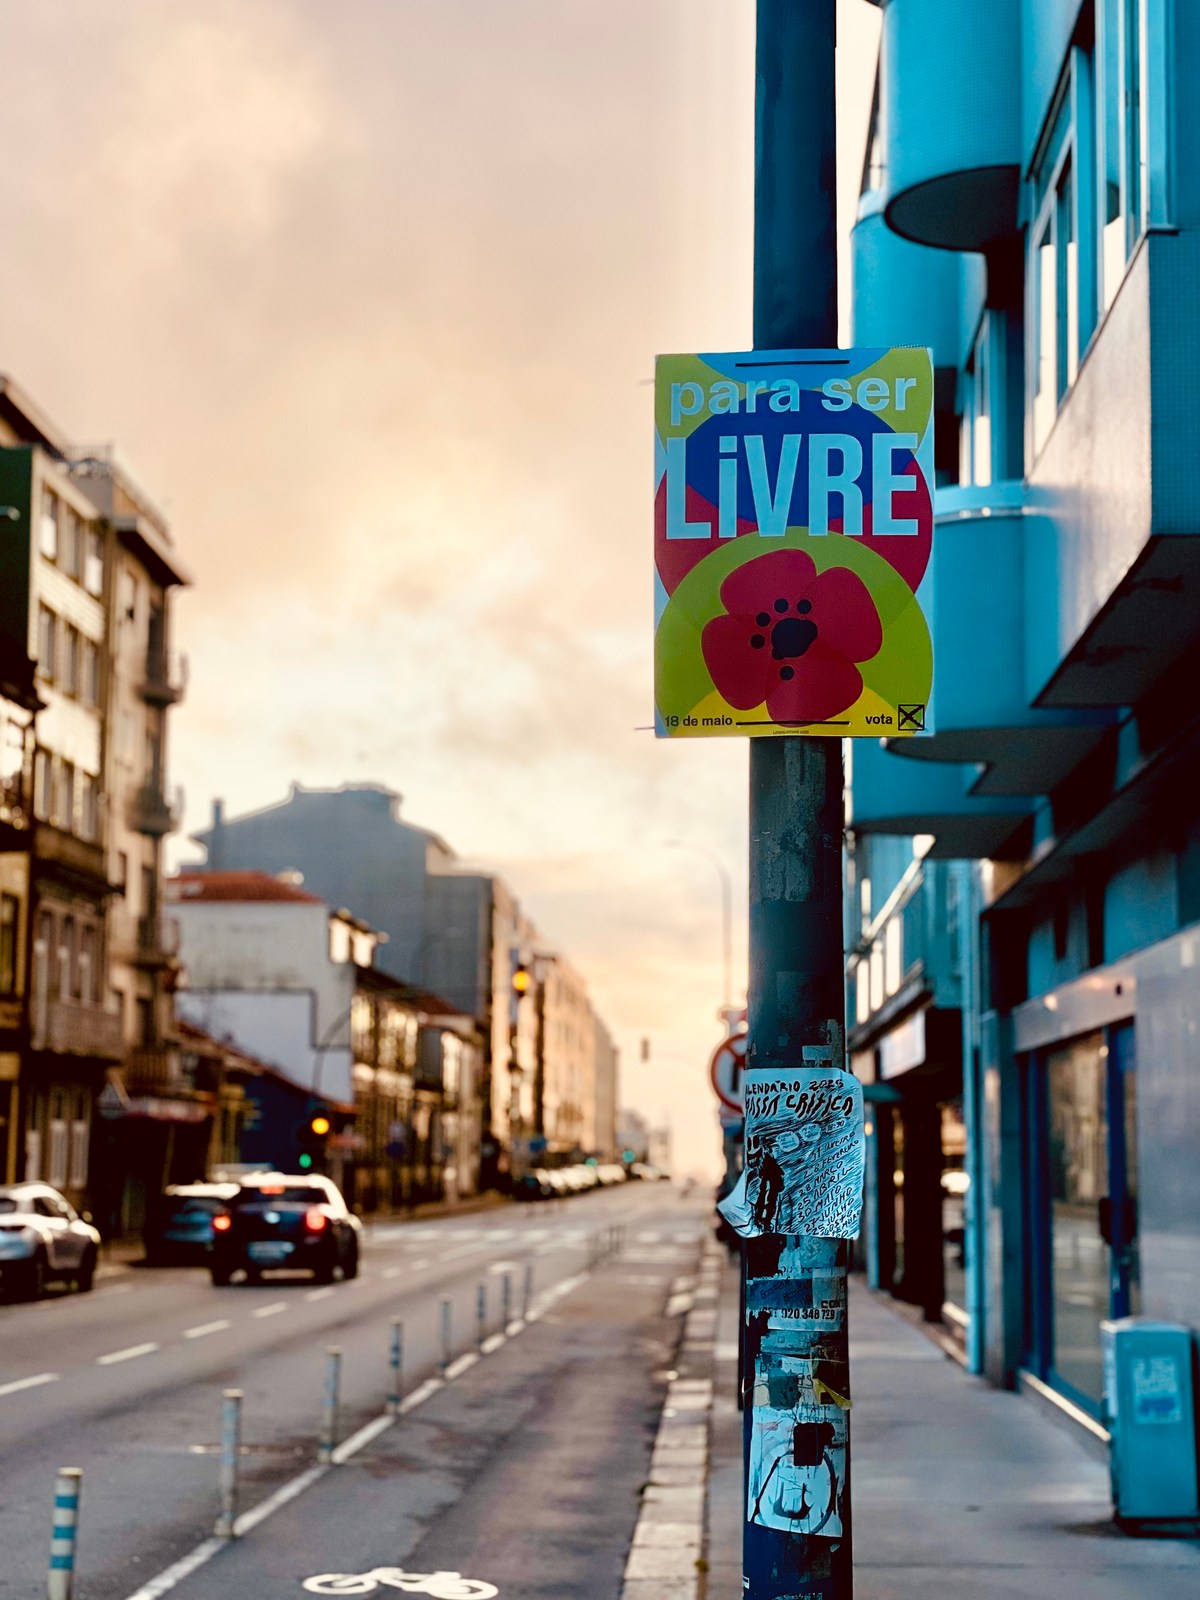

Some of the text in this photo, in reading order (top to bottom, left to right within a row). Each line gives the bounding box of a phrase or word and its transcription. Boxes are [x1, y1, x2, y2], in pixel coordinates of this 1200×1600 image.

[670, 377, 917, 426] para ser
[666, 432, 919, 540] LiVRE
[665, 715, 733, 727] 18 de maio
[865, 713, 893, 725] vota
[809, 1079, 844, 1091] 2025
[786, 1090, 853, 1119] CRÍTICA
[813, 1166, 855, 1200] ABRIL
[819, 1186, 852, 1222] JUNHO
[802, 1308, 820, 1320] 348
